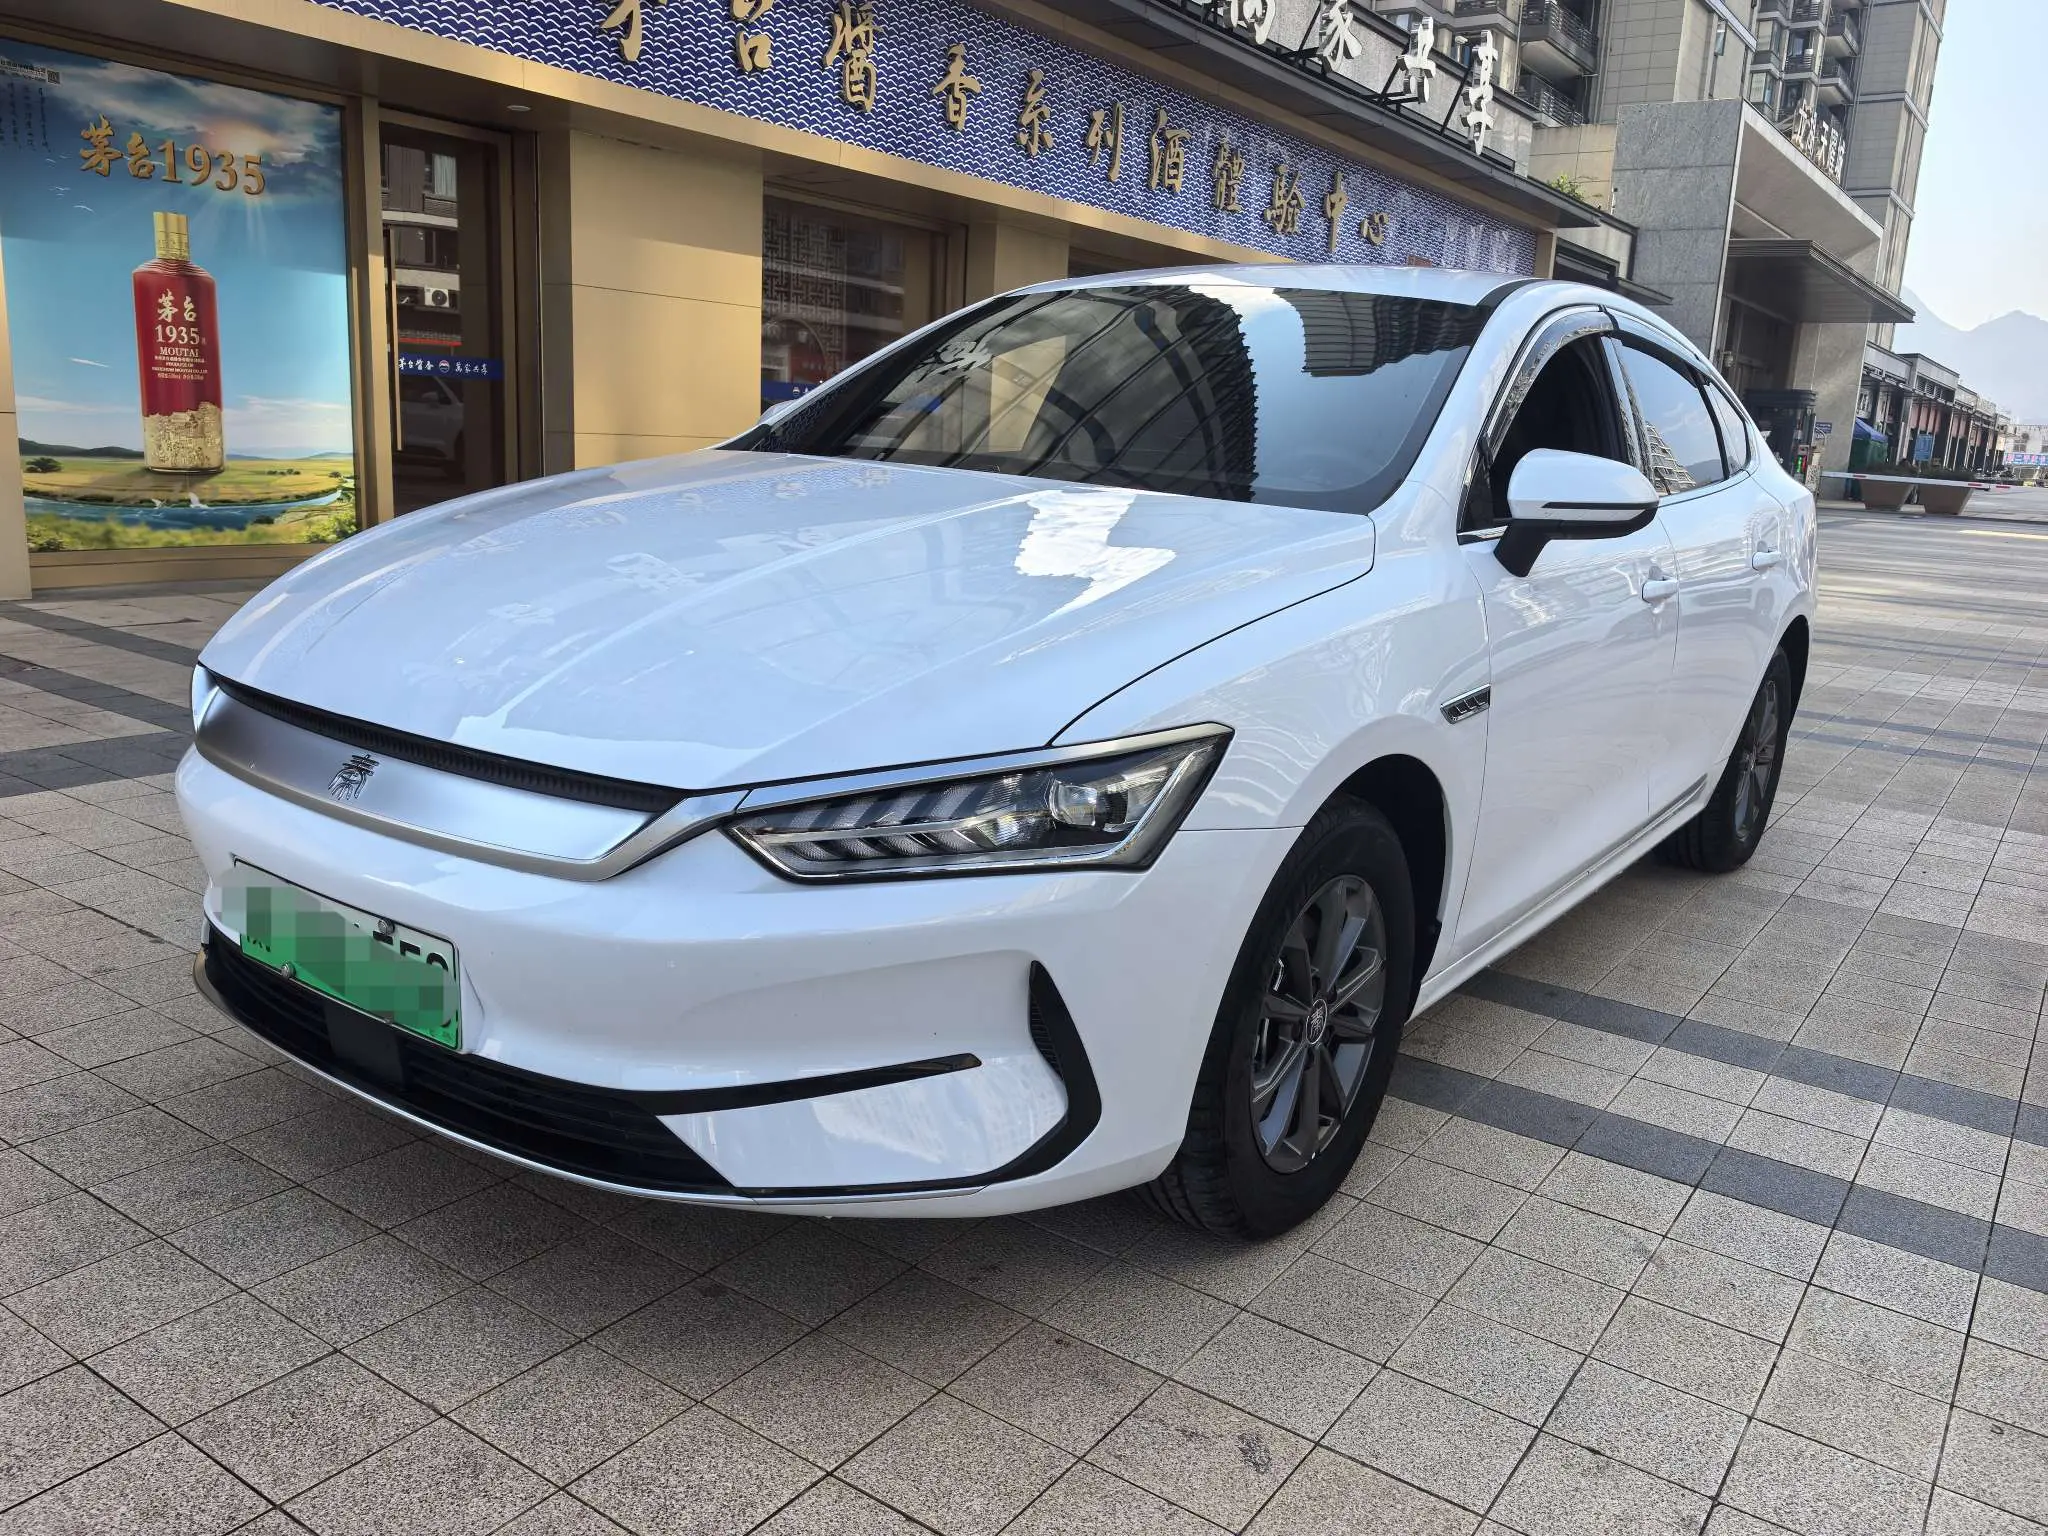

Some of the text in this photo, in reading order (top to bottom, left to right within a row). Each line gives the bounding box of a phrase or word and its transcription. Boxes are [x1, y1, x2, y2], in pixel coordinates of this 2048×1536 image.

[79, 113, 266, 196] 茅台1935
[157, 288, 198, 323] 茅台
[155, 324, 200, 345] 1935
[159, 346, 200, 358] MOUTAI
